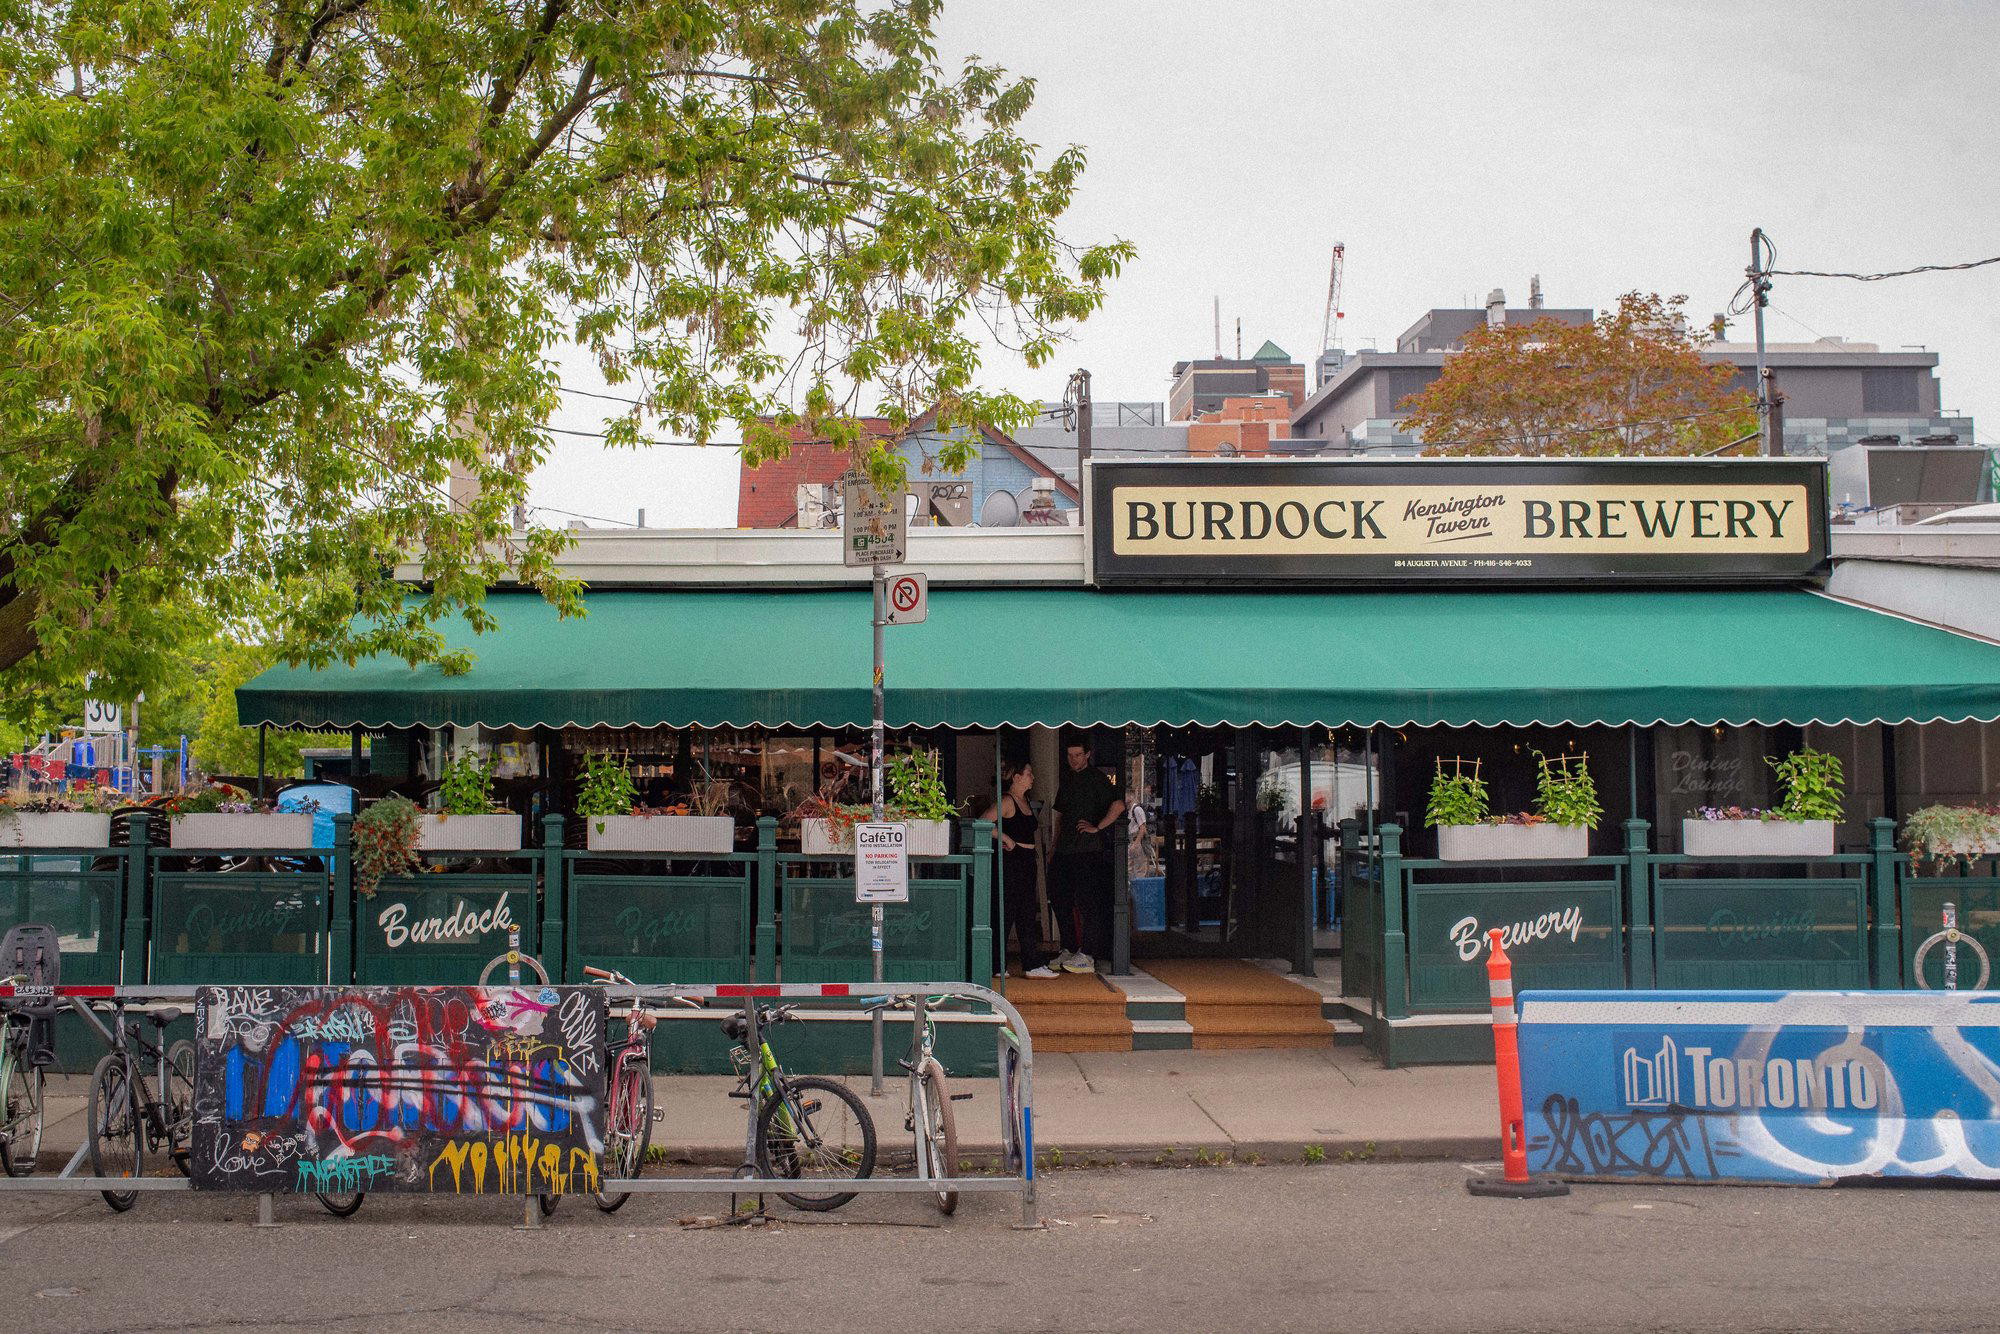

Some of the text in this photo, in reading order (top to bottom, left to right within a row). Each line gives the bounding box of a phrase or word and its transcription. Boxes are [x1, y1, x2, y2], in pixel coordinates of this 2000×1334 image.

[931, 484, 968, 501] 2022
[1126, 500, 1387, 541] BURDOCK
[1403, 494, 1505, 521] Kensington
[1523, 499, 1794, 540] BREWERY
[1427, 516, 1490, 538] Tavern
[89, 701, 116, 722] 30
[1671, 751, 1743, 779] Dining
[1671, 773, 1745, 799] Lounge
[860, 832, 903, 843] CaféTO
[379, 891, 512, 948] Burdock
[208, 1132, 287, 1176] love
